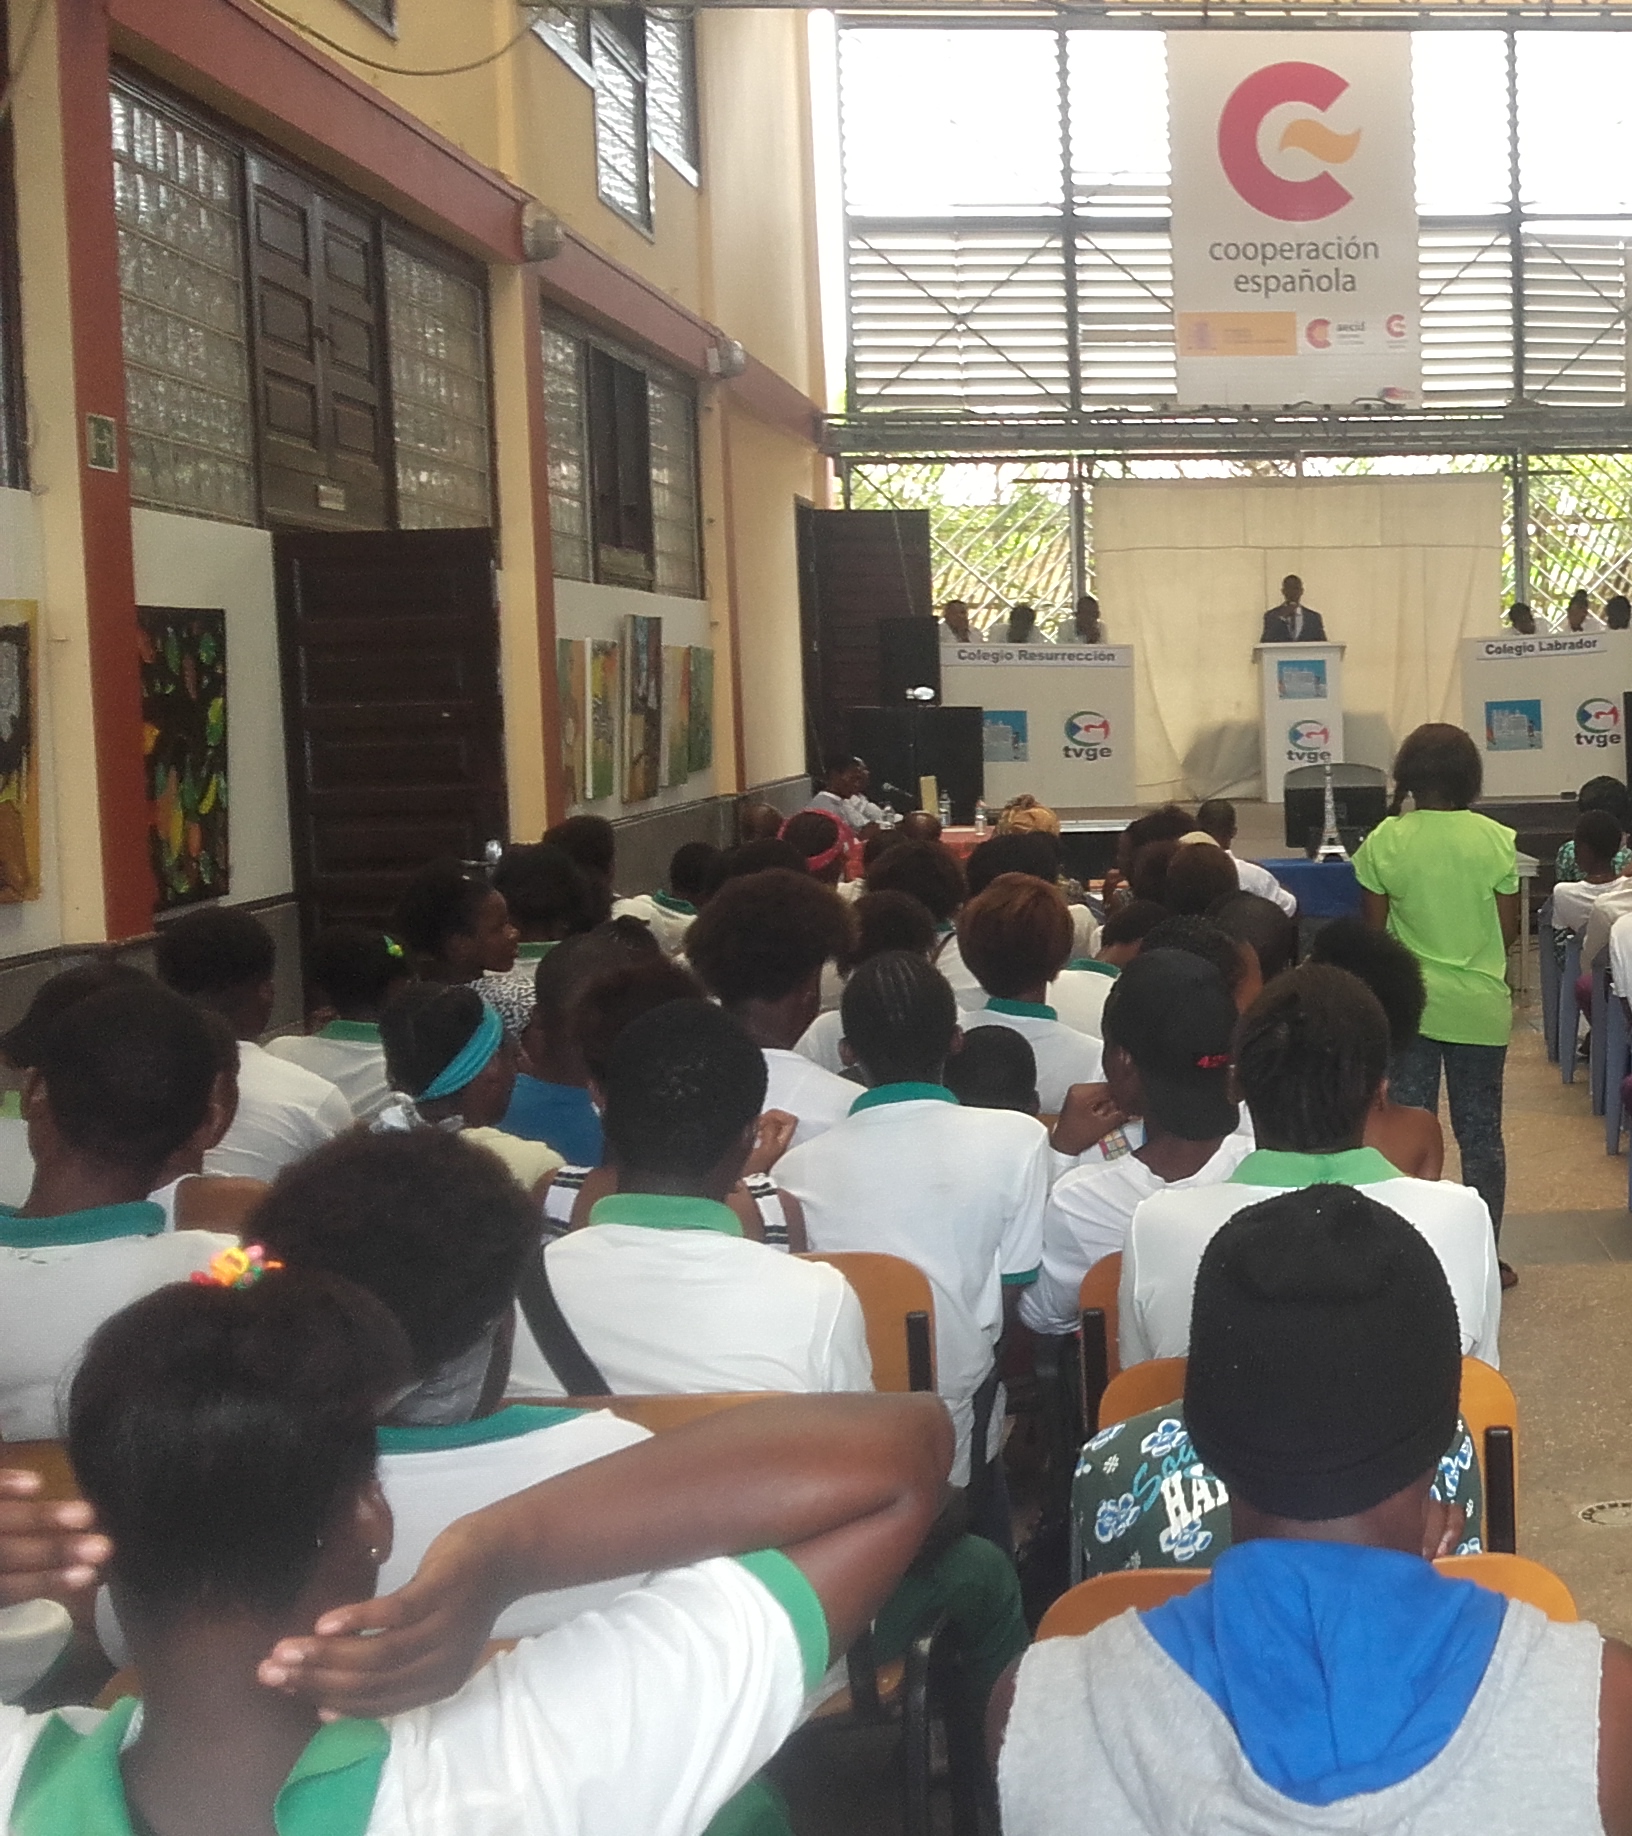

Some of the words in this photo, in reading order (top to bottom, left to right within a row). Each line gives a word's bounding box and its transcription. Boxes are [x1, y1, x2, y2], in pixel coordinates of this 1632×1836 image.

[1209, 235, 1380, 267] cooperación
[1234, 267, 1357, 298] española
[1485, 642, 1535, 656] Colegio
[1539, 638, 1597, 652] Labrador
[957, 649, 1013, 664] Colegio
[1018, 649, 1115, 662] Resurrección
[1575, 732, 1621, 748] tvge
[1063, 745, 1112, 761] tvge
[1286, 750, 1331, 763] tvge
